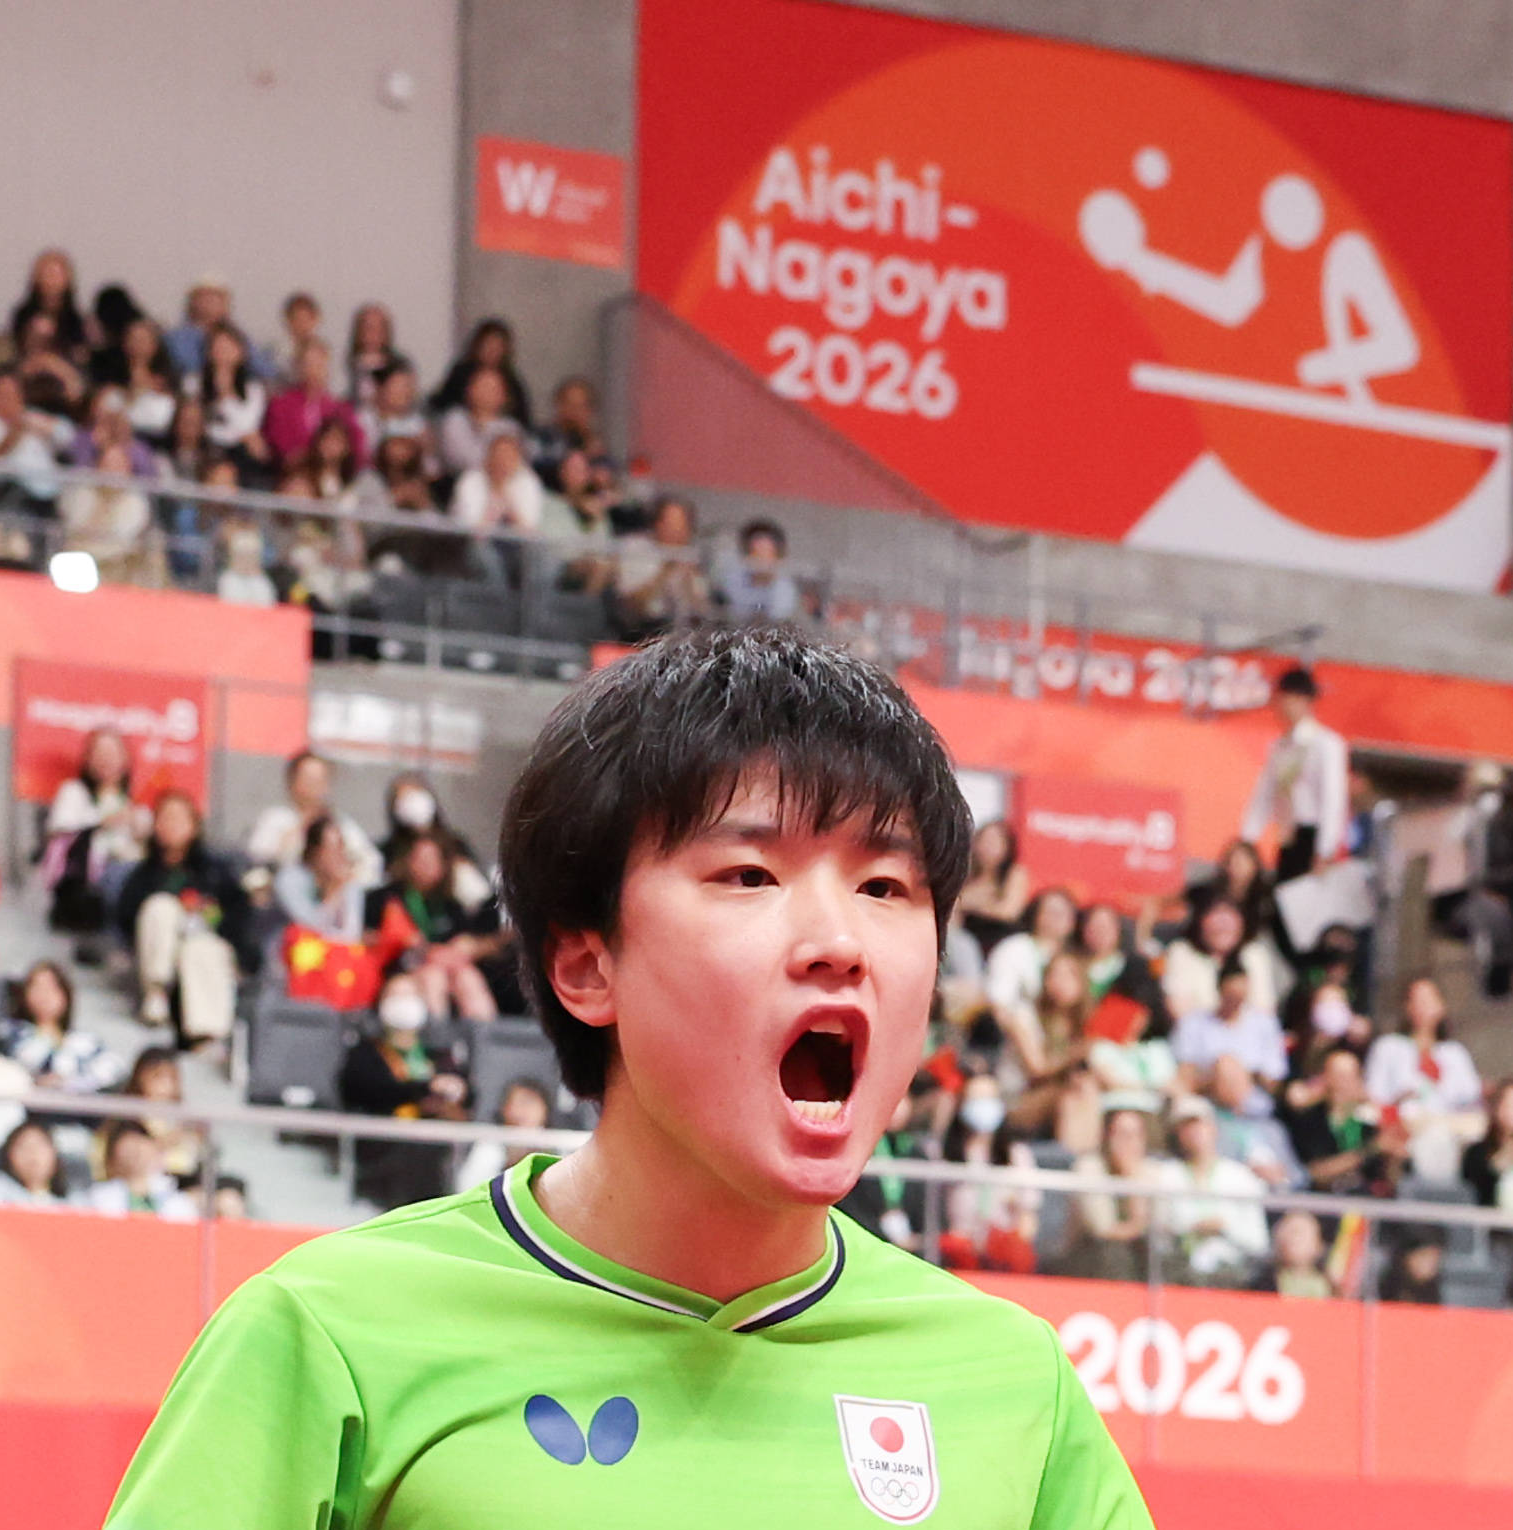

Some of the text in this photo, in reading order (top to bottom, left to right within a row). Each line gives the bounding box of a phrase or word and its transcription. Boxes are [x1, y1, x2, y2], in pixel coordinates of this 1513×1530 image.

[495, 157, 557, 219] W
[754, 147, 978, 242] Aichi-
[716, 217, 1008, 342] Nagoya
[767, 327, 959, 420] 2026
[1058, 1311, 1306, 1426] 2026
[859, 1458, 924, 1477] TEAM JAPAN
